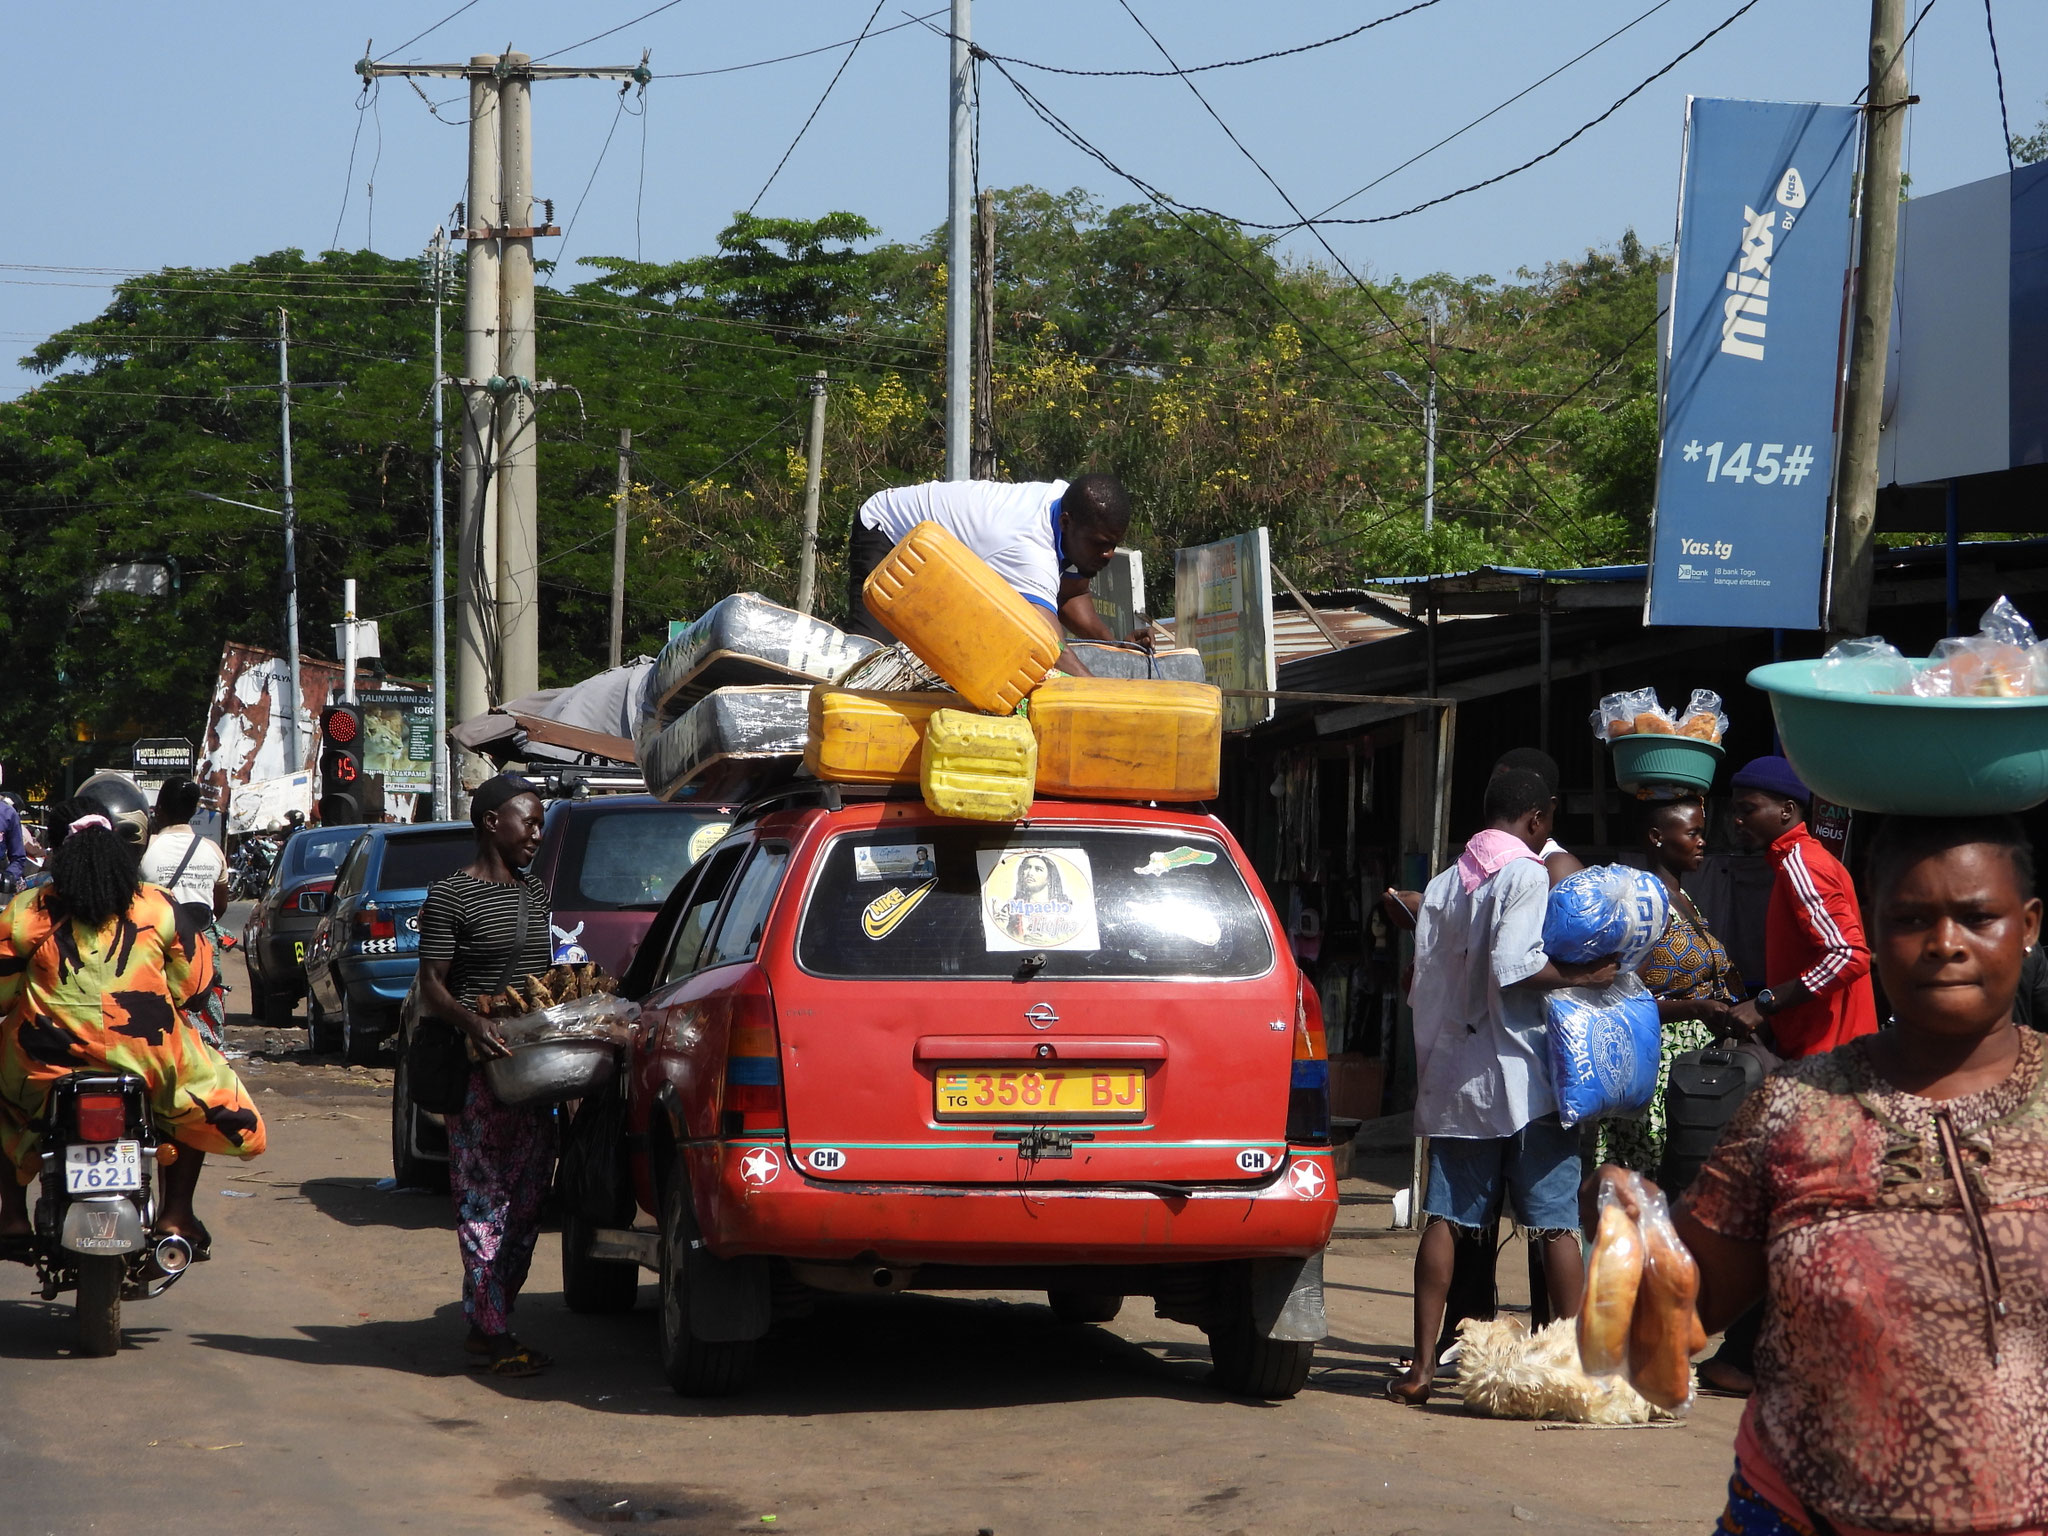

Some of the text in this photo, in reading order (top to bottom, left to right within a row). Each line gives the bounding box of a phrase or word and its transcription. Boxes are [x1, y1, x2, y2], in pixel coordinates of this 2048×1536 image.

[1782, 211, 1796, 230] By
[1721, 205, 1775, 360] mixx
[1681, 538, 1733, 560] Yas.tg
[1714, 577, 1738, 586] banque
[1722, 567, 1738, 575] bank
[1740, 568, 1756, 577] Togo
[400, 694, 417, 703] MINI
[338, 757, 356, 781] 15
[870, 889, 905, 916] NIKE
[946, 1073, 1136, 1107] TG 3587 BJ
[86, 1146, 135, 1166] DS TG
[814, 1151, 839, 1167] CH
[1241, 1152, 1264, 1168] CH
[70, 1167, 136, 1189] 7621
